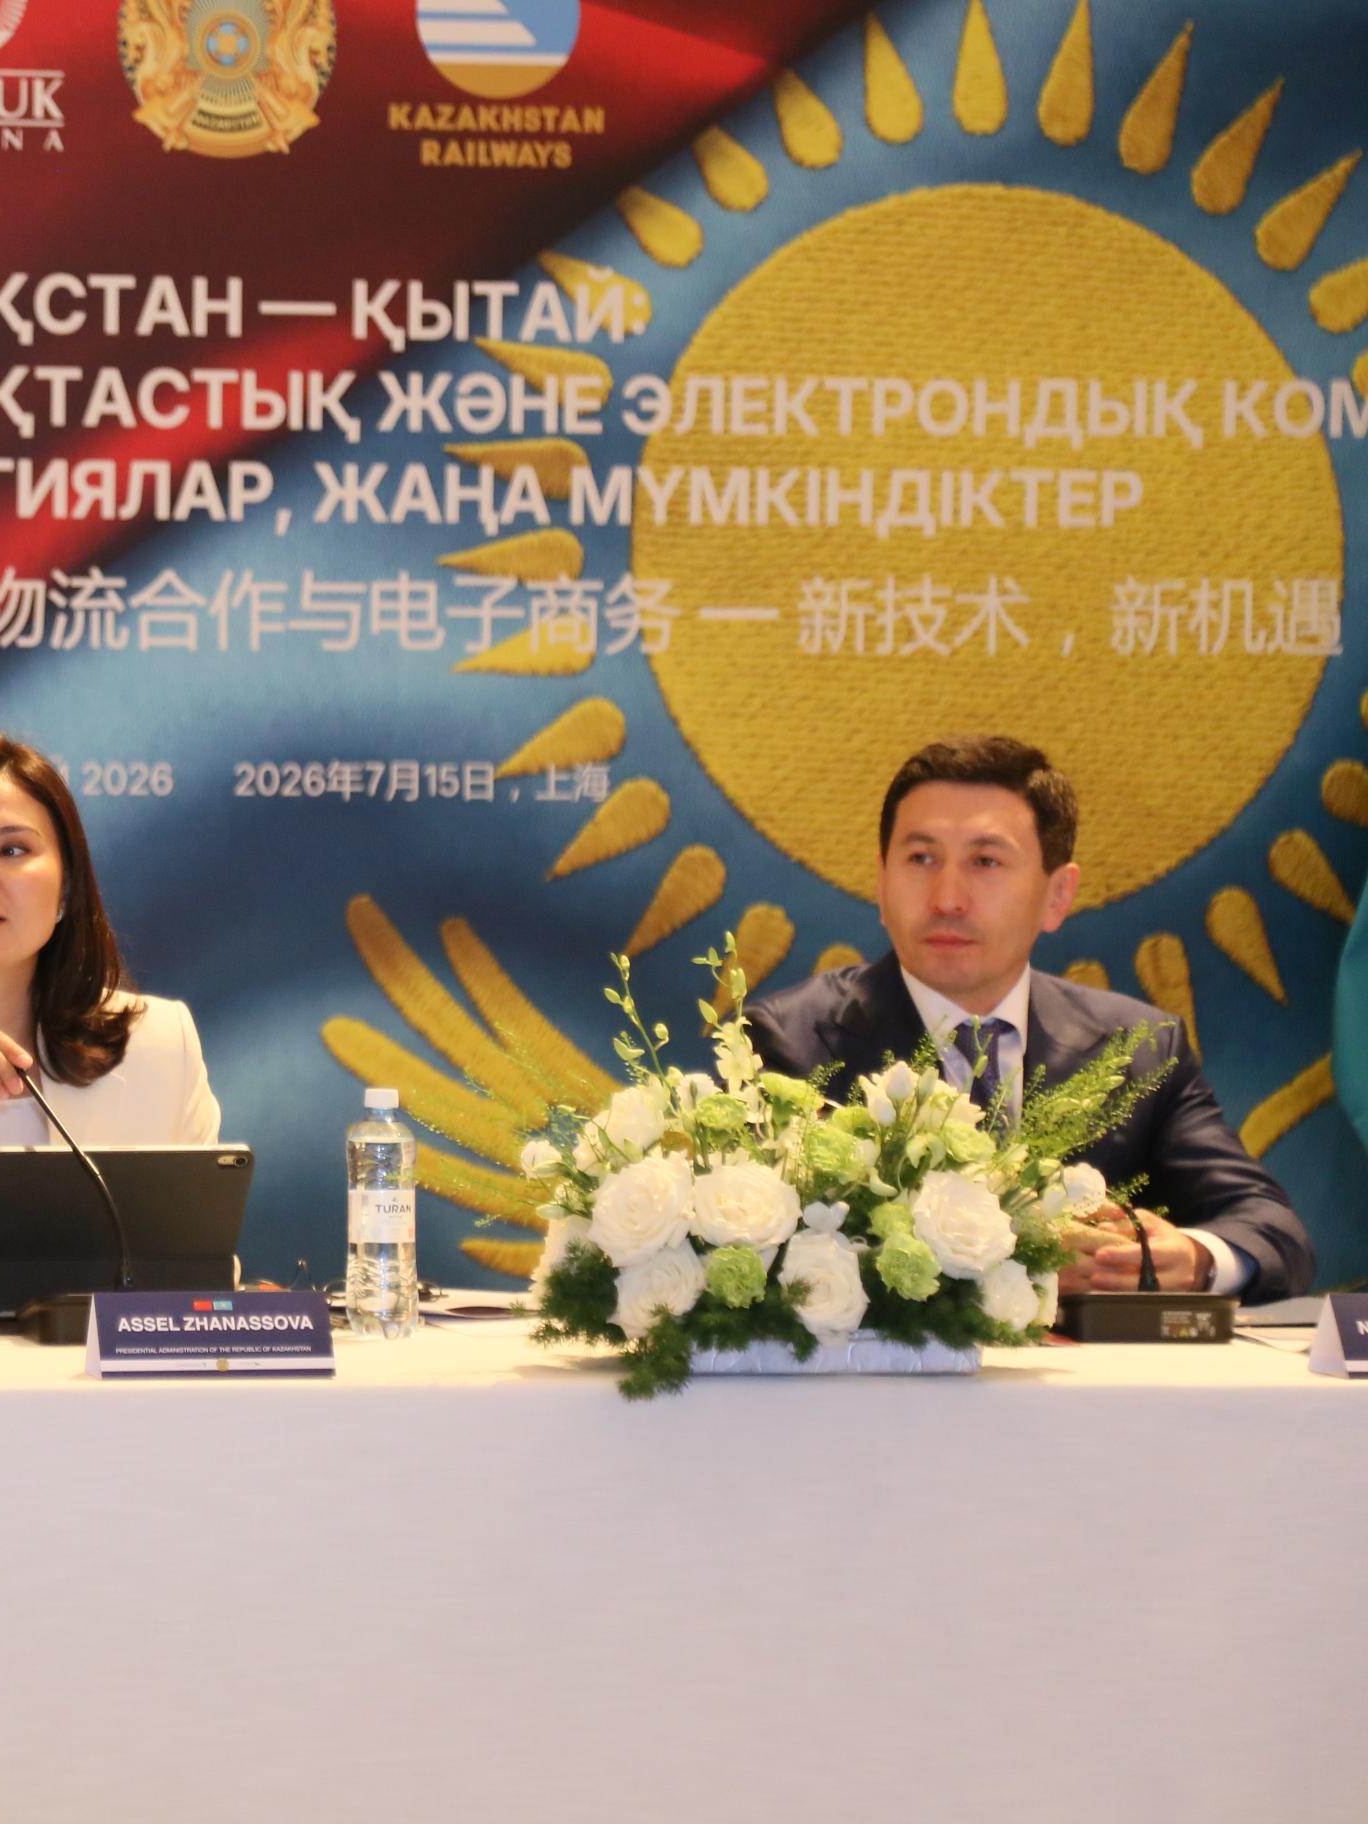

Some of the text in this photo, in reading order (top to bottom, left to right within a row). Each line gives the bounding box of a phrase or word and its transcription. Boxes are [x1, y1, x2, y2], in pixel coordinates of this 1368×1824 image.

[387, 102, 605, 134] KAZAKHSTAN
[420, 138, 573, 168] RAILWAYS
[378, 370, 604, 436] ЖӘНЕ
[621, 373, 1203, 450] ЭЛЕКТРОНДЫҚ
[313, 462, 551, 535] ЖАҢА
[569, 465, 1144, 538] МҮМКІНДІКТЕР
[81, 762, 175, 797] 2026
[375, 1204, 412, 1214] TURAN
[118, 1315, 314, 1332] ASSEL ZHANASSOVA
[272, 1345, 312, 1353] KAZAKHSTAN
